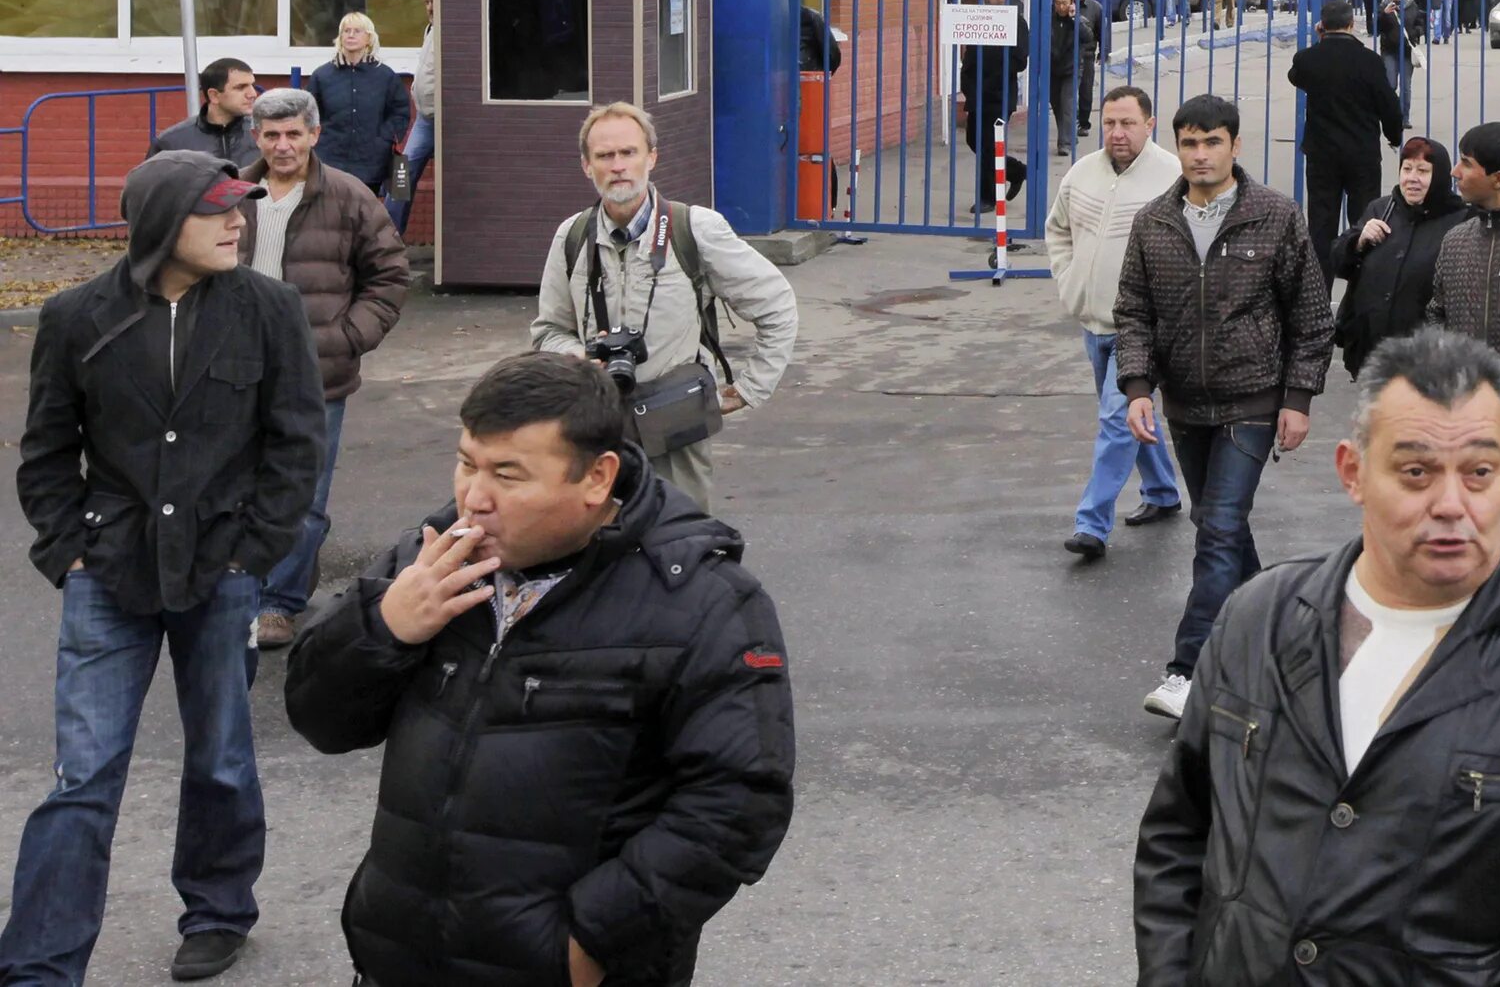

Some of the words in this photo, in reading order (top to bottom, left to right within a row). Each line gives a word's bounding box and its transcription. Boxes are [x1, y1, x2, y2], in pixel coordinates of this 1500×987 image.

[955, 23, 990, 31] СТРОГО
[953, 31, 1007, 39] ПРОПУСКАМ
[657, 215, 668, 245] Canon
